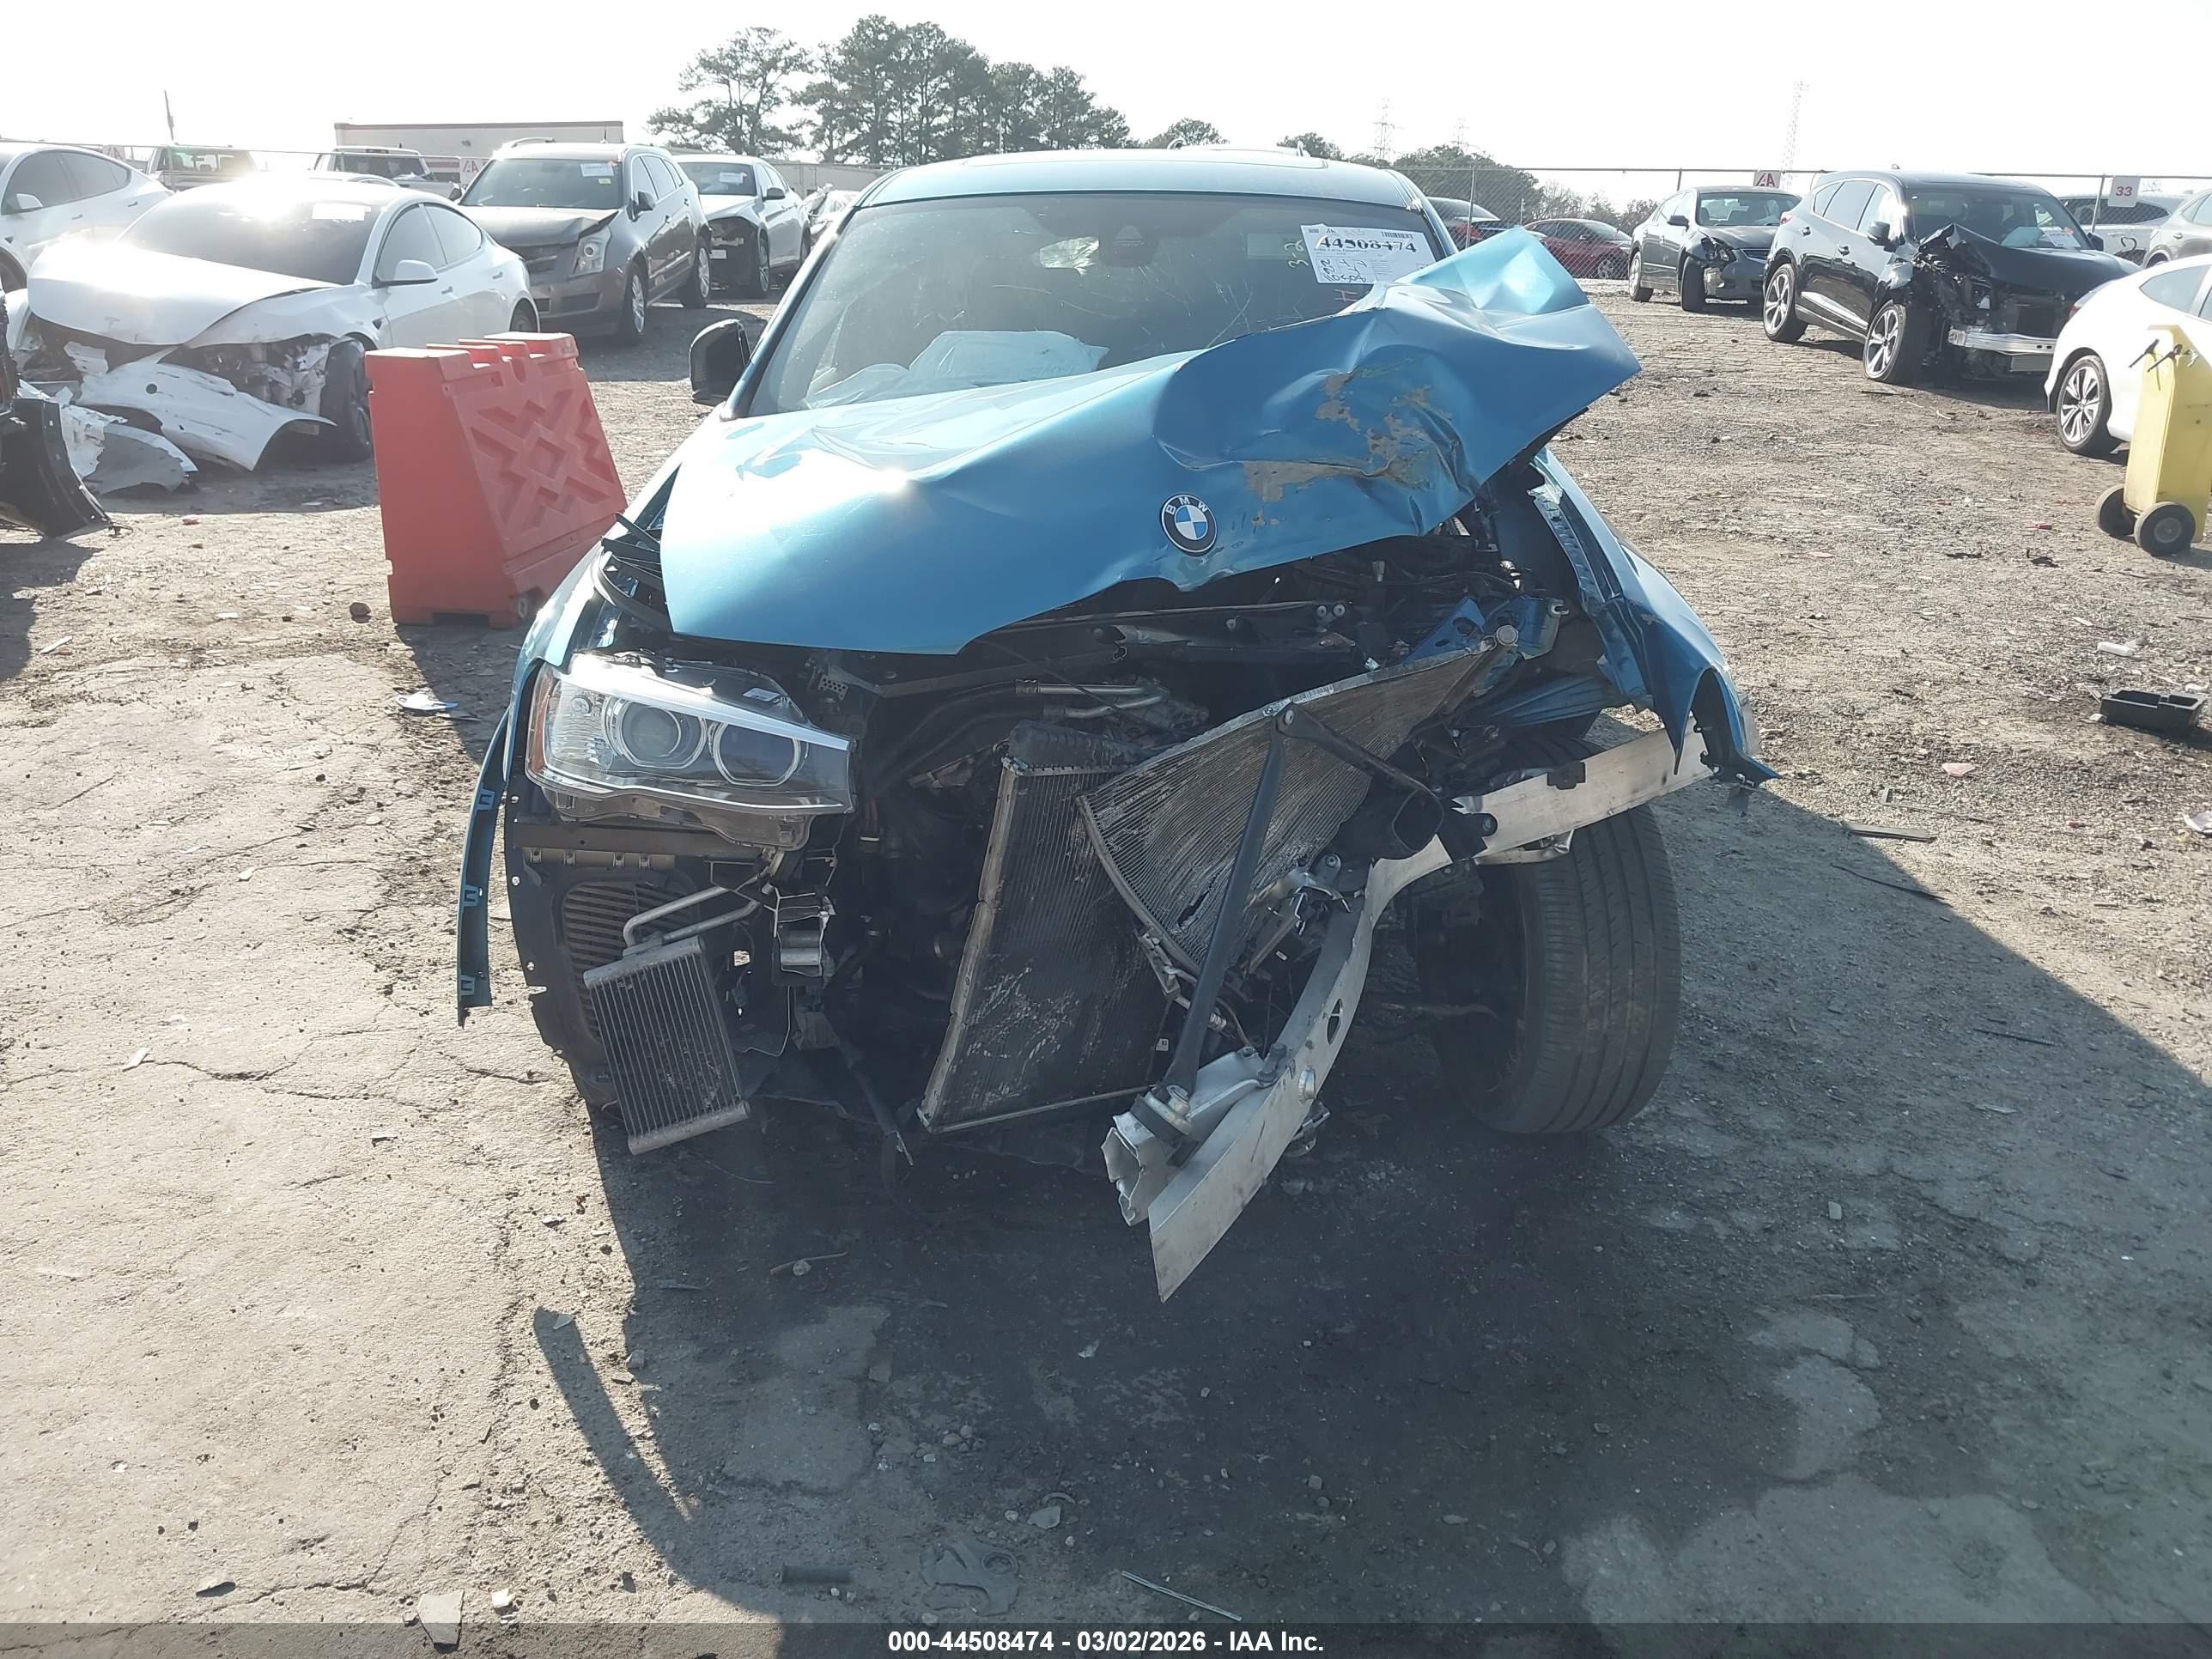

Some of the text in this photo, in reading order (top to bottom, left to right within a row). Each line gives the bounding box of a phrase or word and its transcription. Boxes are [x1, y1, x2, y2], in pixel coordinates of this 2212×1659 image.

[2116, 186, 2132, 196] 33
[1317, 236, 1417, 252] 44508474
[1165, 496, 1208, 515] BMW
